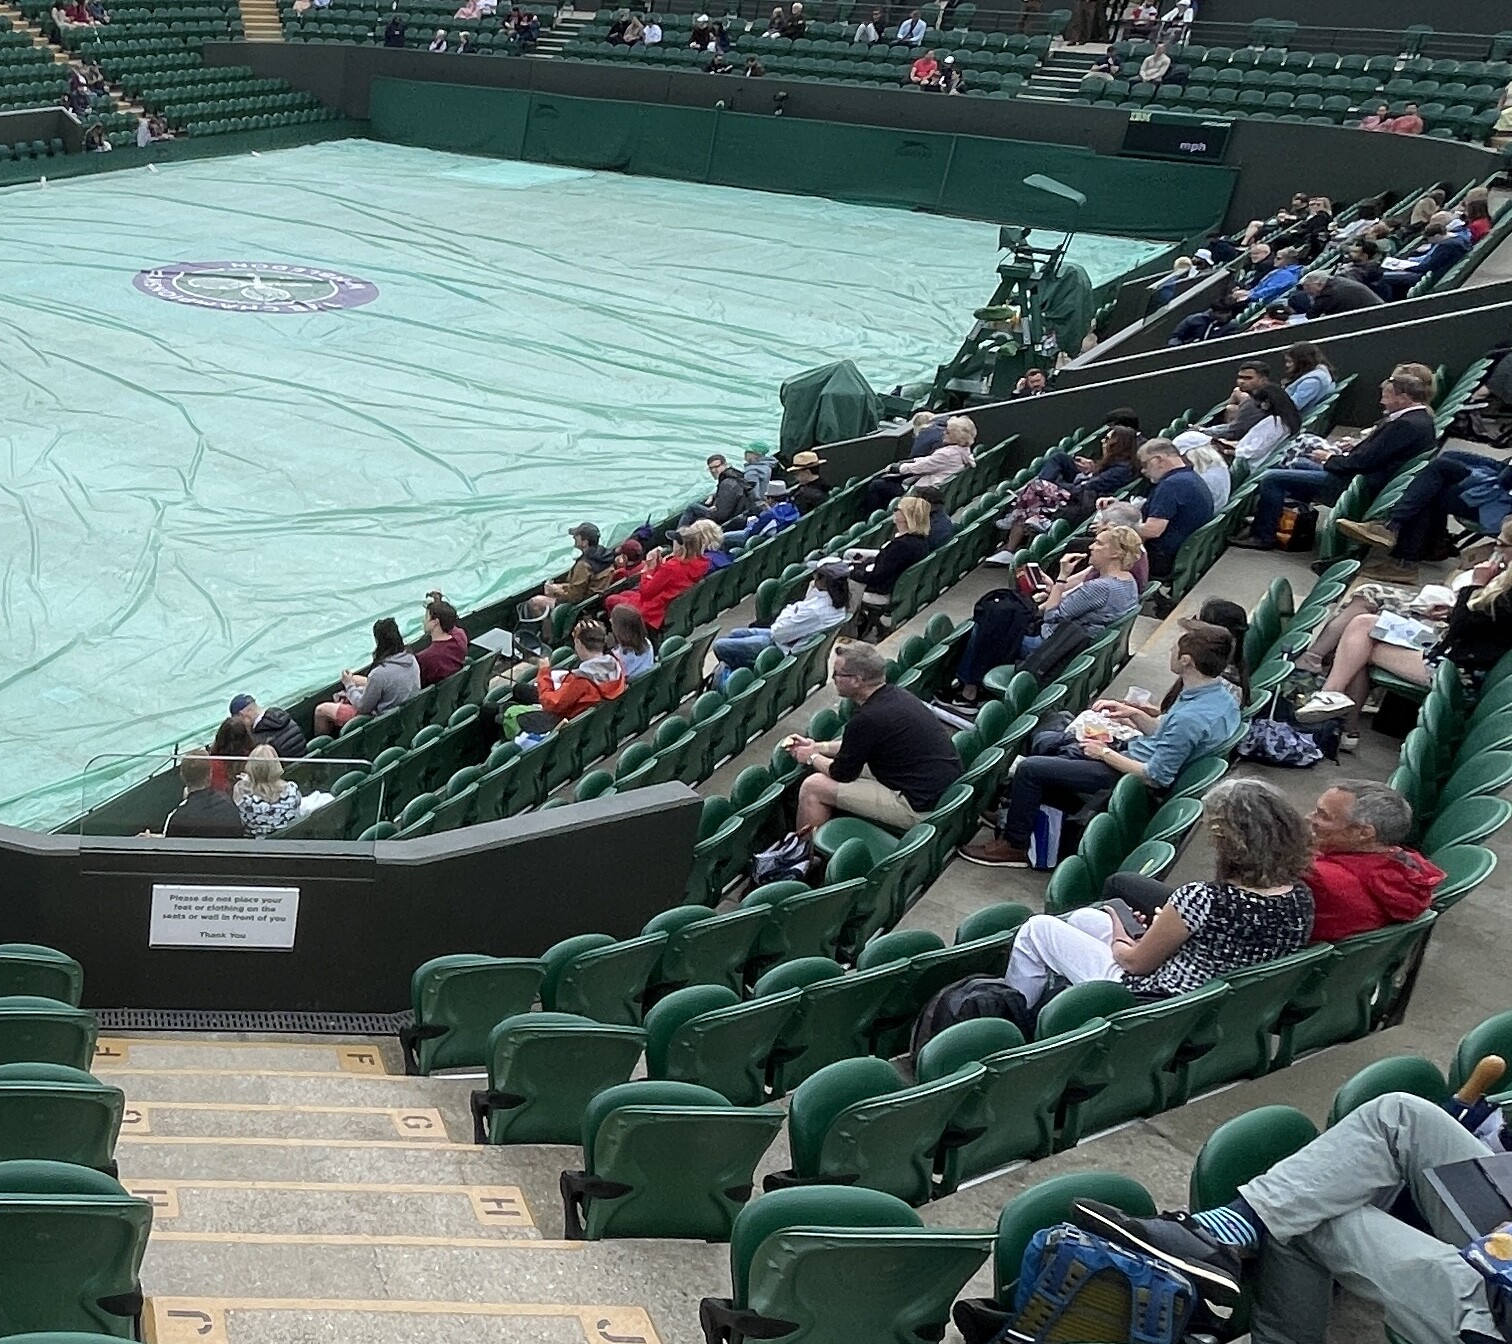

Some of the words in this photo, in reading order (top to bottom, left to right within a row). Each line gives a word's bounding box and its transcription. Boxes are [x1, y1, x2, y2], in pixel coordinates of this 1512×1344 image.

[1180, 142, 1206, 152] mph
[169, 894, 199, 902] Please
[234, 896, 258, 904] place
[174, 903, 192, 911] feet
[206, 904, 245, 913] clothing
[261, 905, 276, 913] the
[232, 914, 255, 922] front
[199, 931, 227, 939] Thank
[346, 1053, 376, 1066] F
[401, 1115, 433, 1129] G
[480, 1197, 521, 1216] H
[167, 1309, 213, 1335] J
[596, 1318, 648, 1344] J
